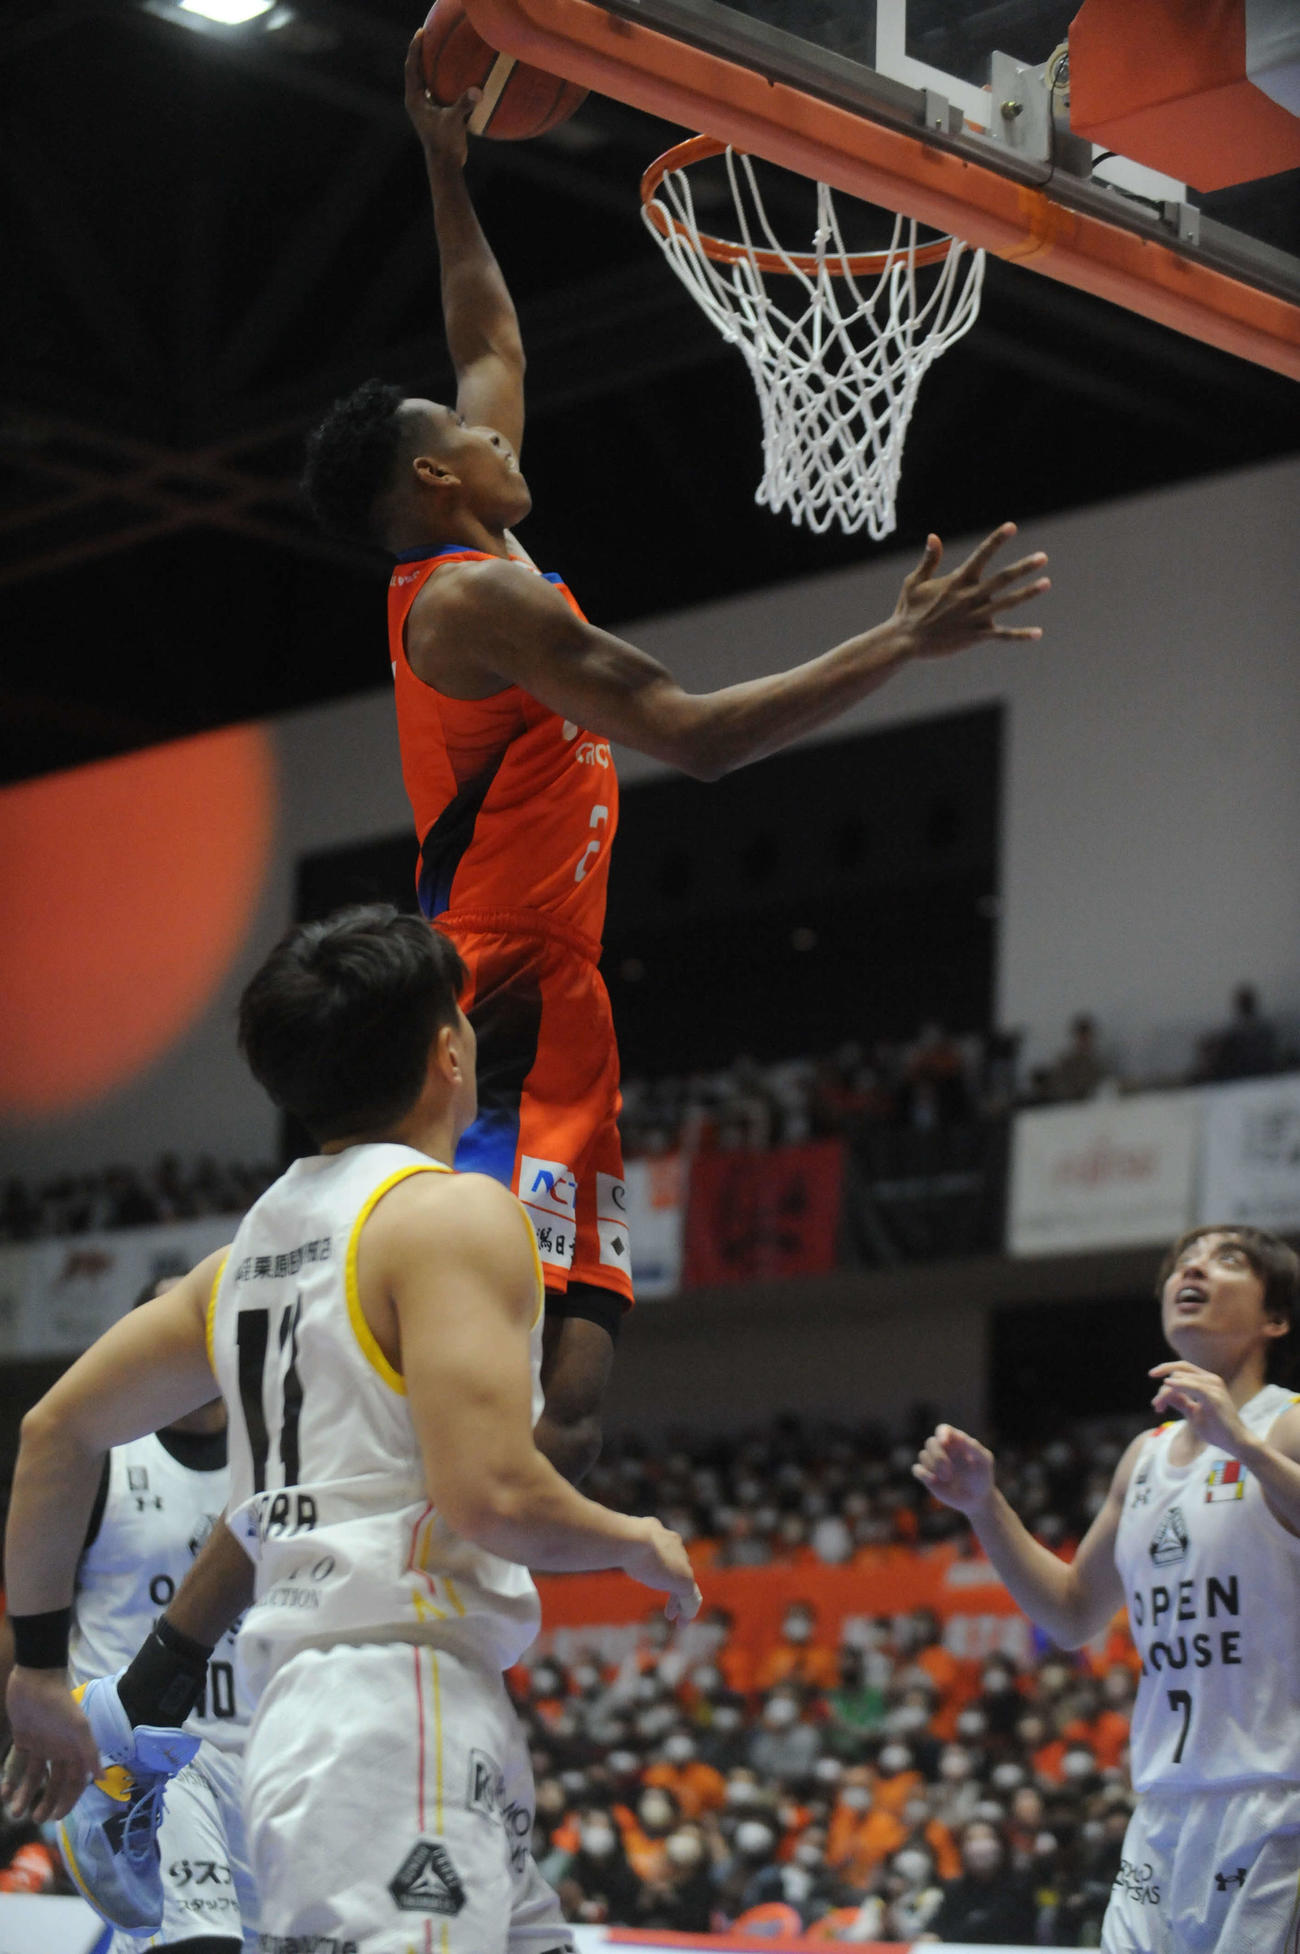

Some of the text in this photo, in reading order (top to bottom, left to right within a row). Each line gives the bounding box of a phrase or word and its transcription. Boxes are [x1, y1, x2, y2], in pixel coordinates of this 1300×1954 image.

[1134, 1575, 1239, 1626] OPEN
[1142, 1631, 1243, 1677] OUSE
[1167, 1689, 1193, 1764] 7
